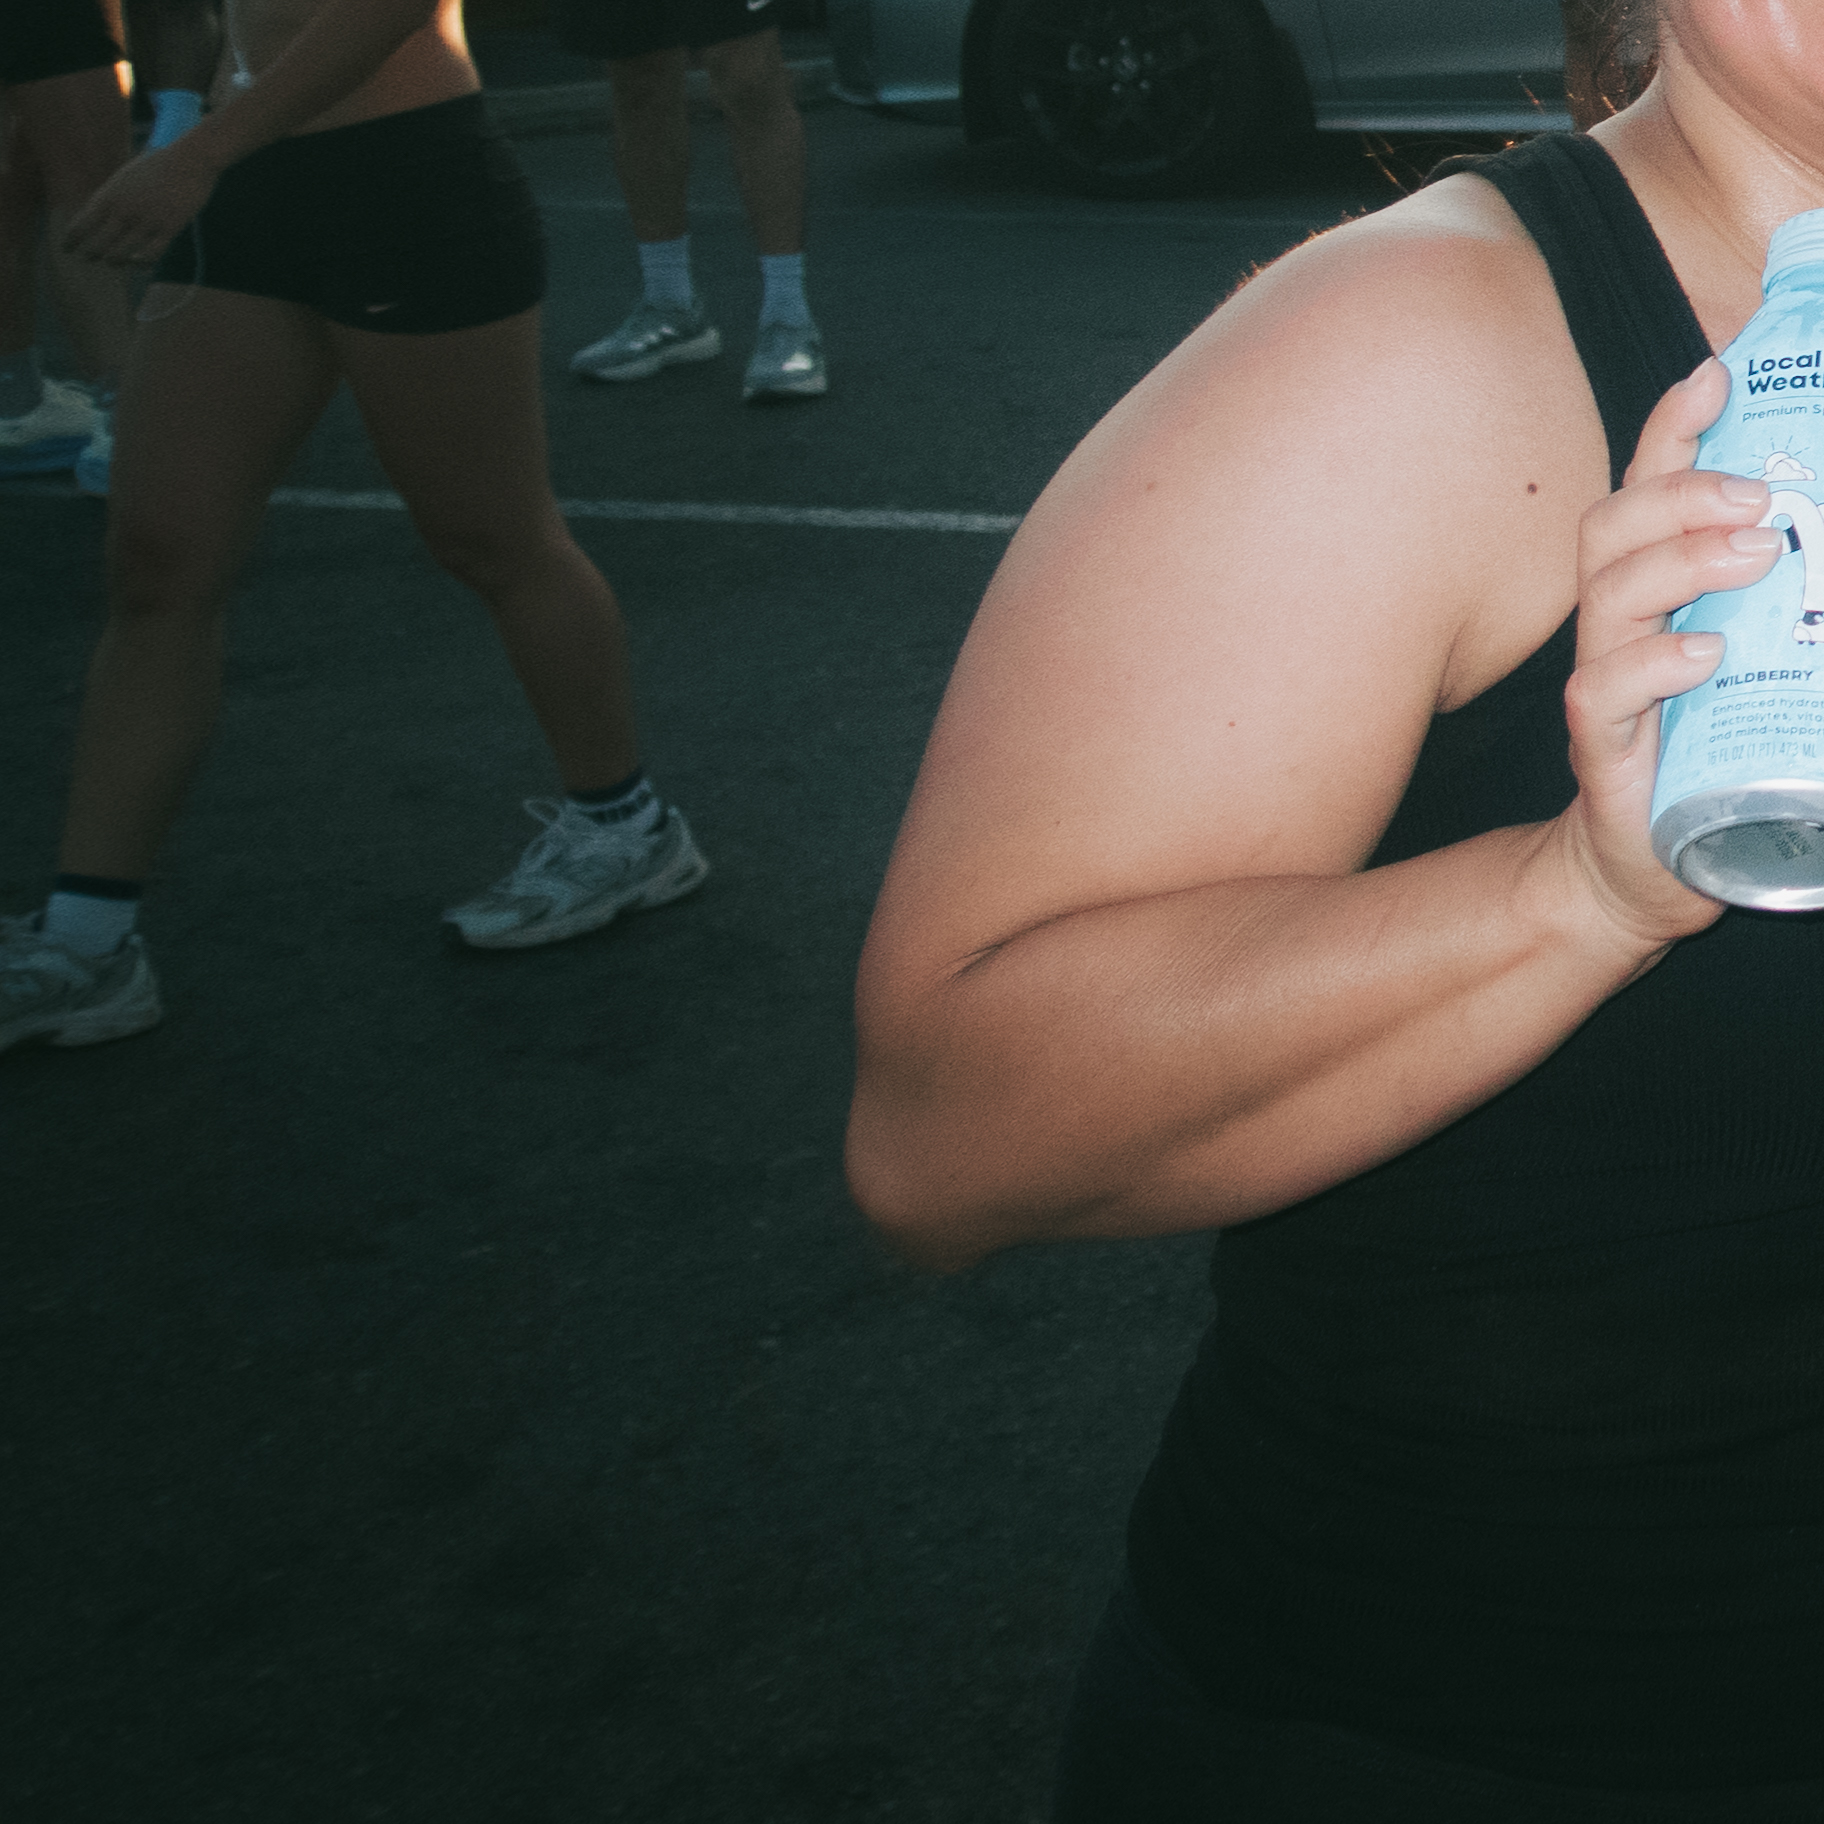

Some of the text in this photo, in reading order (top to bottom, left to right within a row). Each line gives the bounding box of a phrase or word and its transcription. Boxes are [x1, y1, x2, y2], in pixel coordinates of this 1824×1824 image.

[1748, 350, 1822, 377] Local
[1742, 405, 1807, 423] Premium
[1715, 670, 1814, 690] WILDBERRY
[1712, 698, 1776, 717] Enhanced
[1710, 712, 1792, 730] electrolytes,
[1708, 730, 1732, 743] and
[1719, 747, 1729, 763] FL
[1803, 742, 1816, 758] ML
